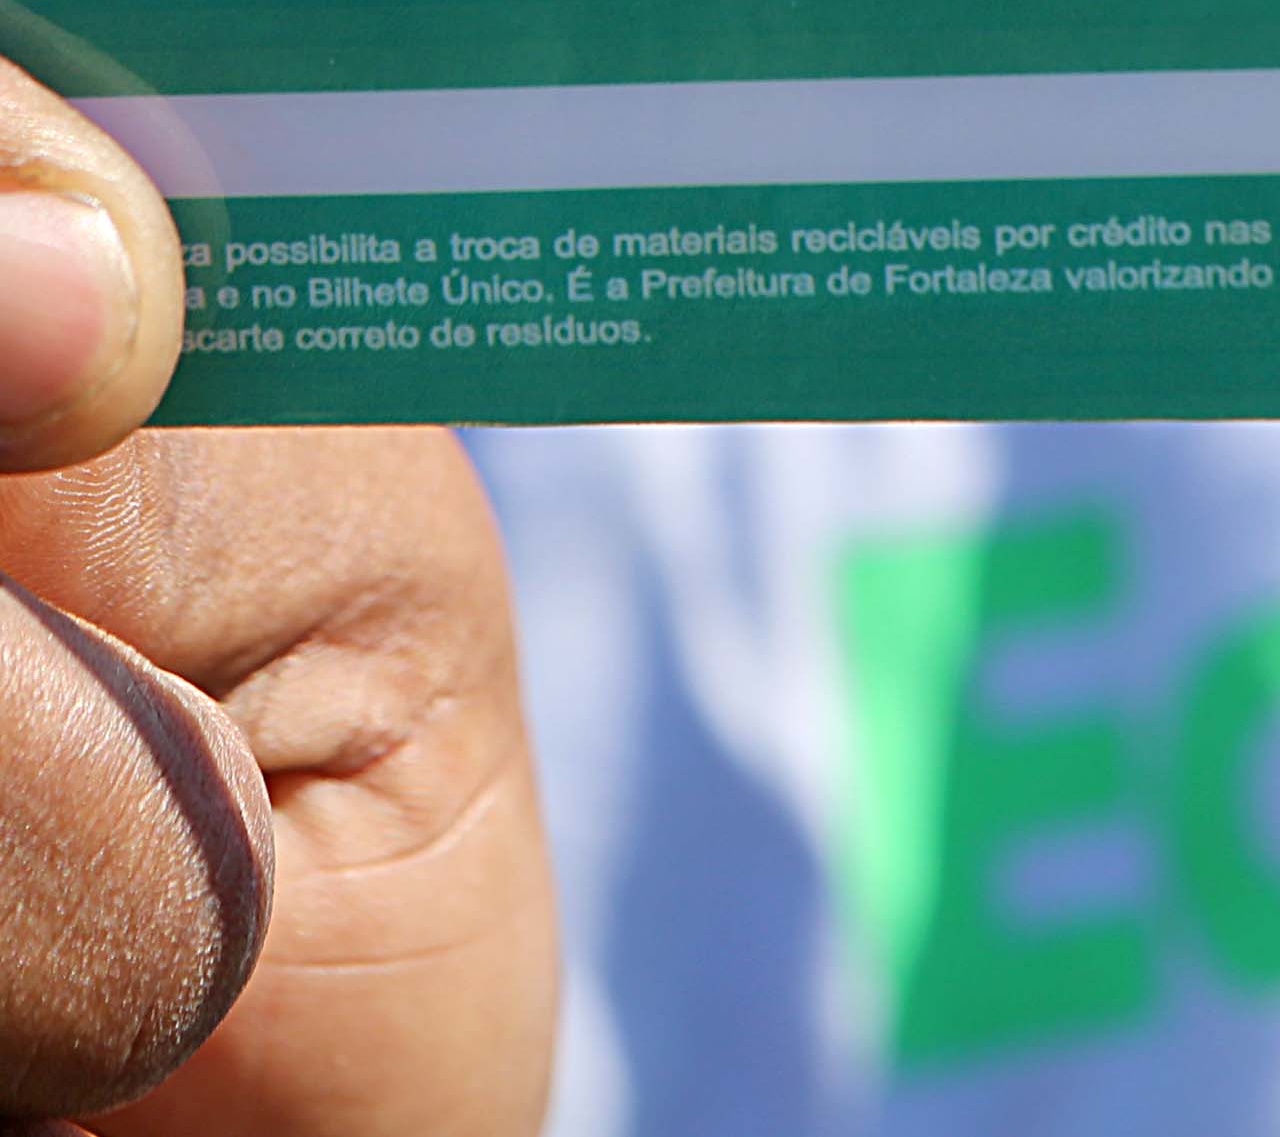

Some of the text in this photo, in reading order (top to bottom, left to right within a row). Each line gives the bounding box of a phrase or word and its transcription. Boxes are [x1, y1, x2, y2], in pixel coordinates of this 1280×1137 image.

[226, 233, 401, 272] possibilita
[415, 239, 437, 262] a
[450, 232, 541, 261] troca
[554, 228, 600, 259] de
[614, 223, 778, 256] materiais
[792, 219, 981, 253] recicláveis
[995, 224, 1056, 255] por
[1068, 215, 1192, 247] crédito
[1205, 220, 1272, 245] nas
[218, 287, 239, 308] e
[253, 285, 296, 308] no
[309, 277, 429, 307] Bilhete
[442, 268, 553, 304] Único.
[568, 265, 593, 301] É
[607, 278, 629, 300] a
[642, 265, 814, 301] Prefeitura
[827, 265, 872, 295] de
[885, 263, 1053, 295] Fortaleza
[1065, 258, 1273, 290] valorizando
[296, 320, 419, 350] correto
[430, 318, 476, 348] de
[487, 315, 651, 346] resíduos.
